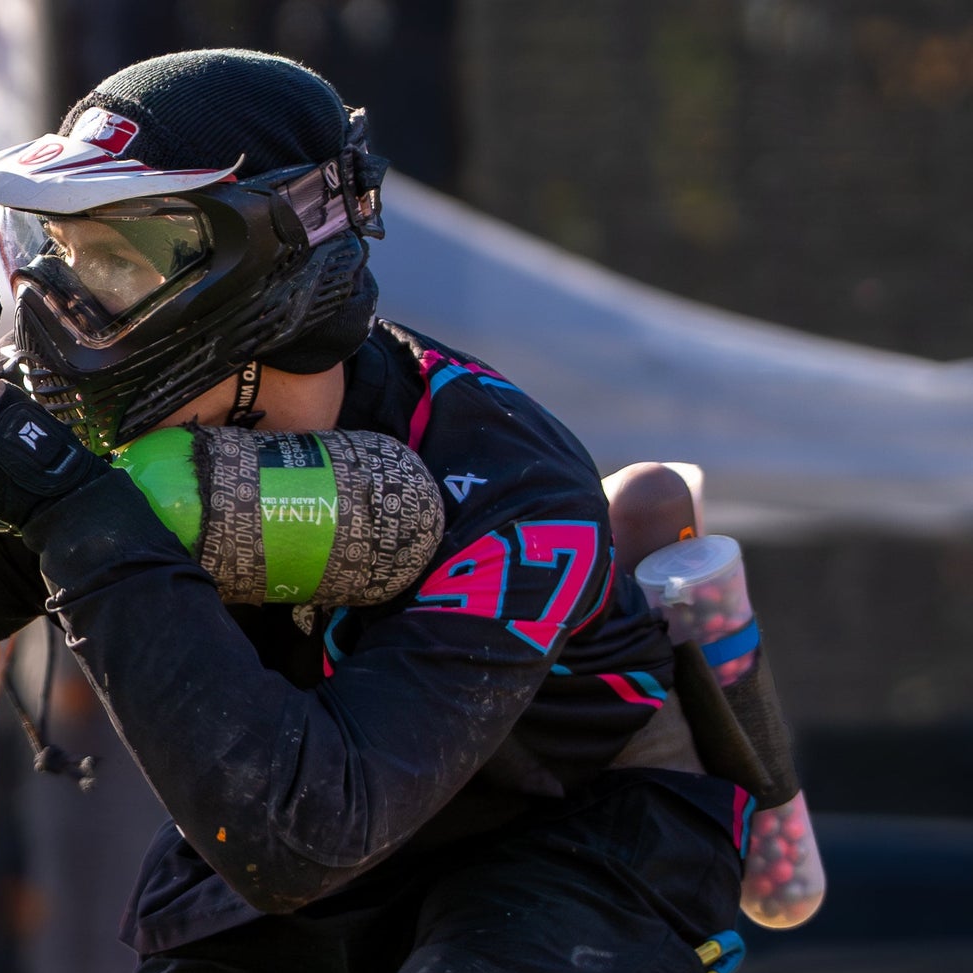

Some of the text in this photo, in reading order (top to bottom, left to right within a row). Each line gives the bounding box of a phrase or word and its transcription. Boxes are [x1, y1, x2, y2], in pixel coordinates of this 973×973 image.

[238, 384, 255, 407] WIN
[239, 451, 258, 481] PRO
[382, 457, 402, 484] DNA
[260, 496, 337, 525] NINJA
[261, 497, 277, 505] USA
[235, 511, 254, 576] PRO DNA
[380, 516, 399, 550] PRO
[372, 551, 395, 581] DNA
[406, 519, 599, 655] 97
